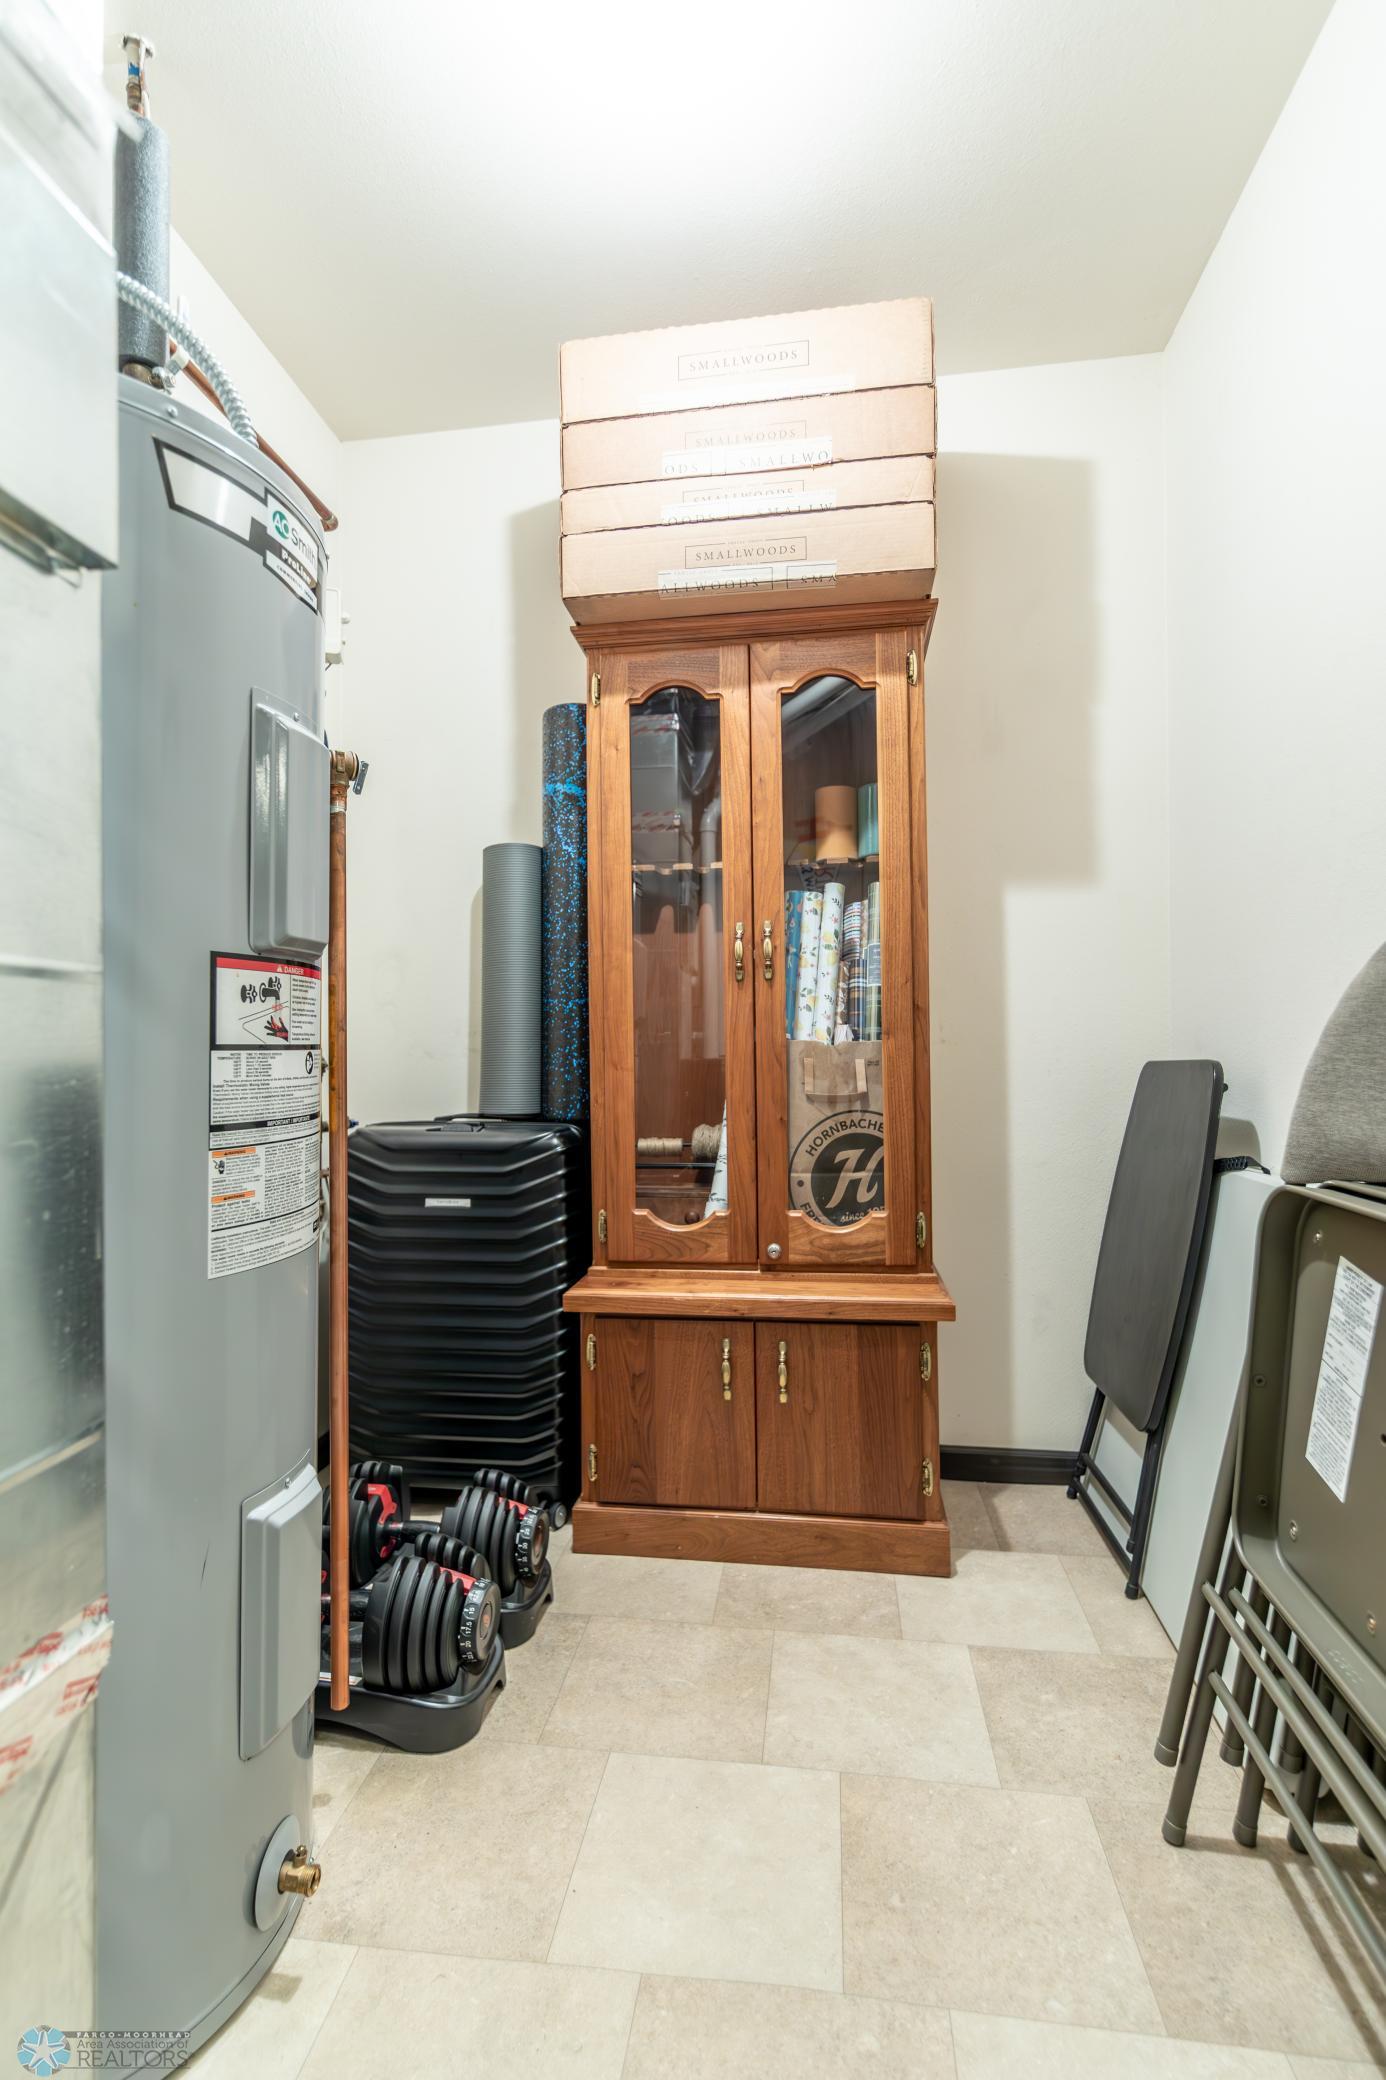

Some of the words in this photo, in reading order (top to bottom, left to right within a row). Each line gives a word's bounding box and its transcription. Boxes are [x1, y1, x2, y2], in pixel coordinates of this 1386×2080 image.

[689, 349, 799, 372] SMALLWOODS
[695, 429, 797, 449] SMALLWOODS
[291, 527, 315, 565] Smith
[695, 544, 797, 562] SMALLWOODS
[284, 966, 305, 976] DANGER
[468, 1607, 476, 1615] 15
[465, 1621, 473, 1634] 17.5
